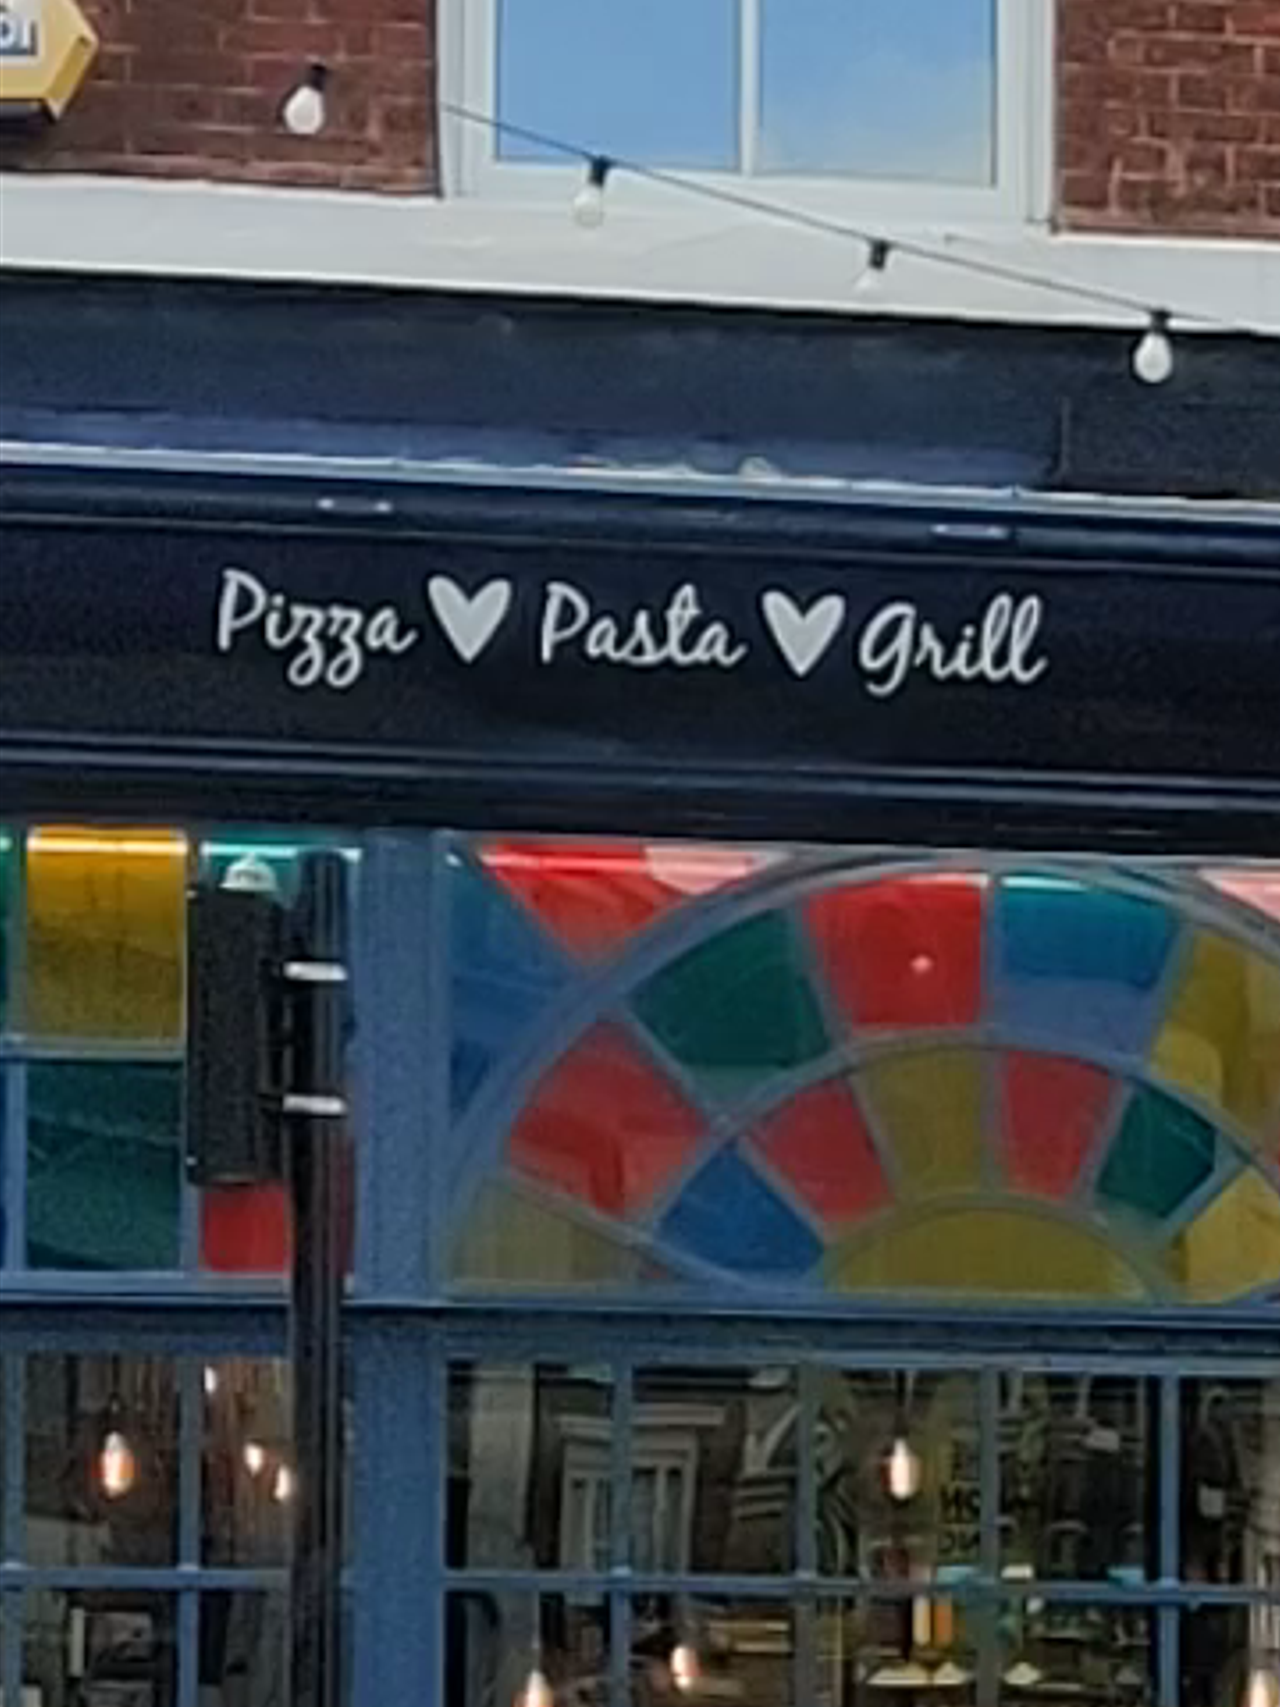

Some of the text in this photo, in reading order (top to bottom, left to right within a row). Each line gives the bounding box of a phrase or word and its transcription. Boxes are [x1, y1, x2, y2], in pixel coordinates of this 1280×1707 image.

[217, 568, 1047, 697] Pizza Pasta Grill
